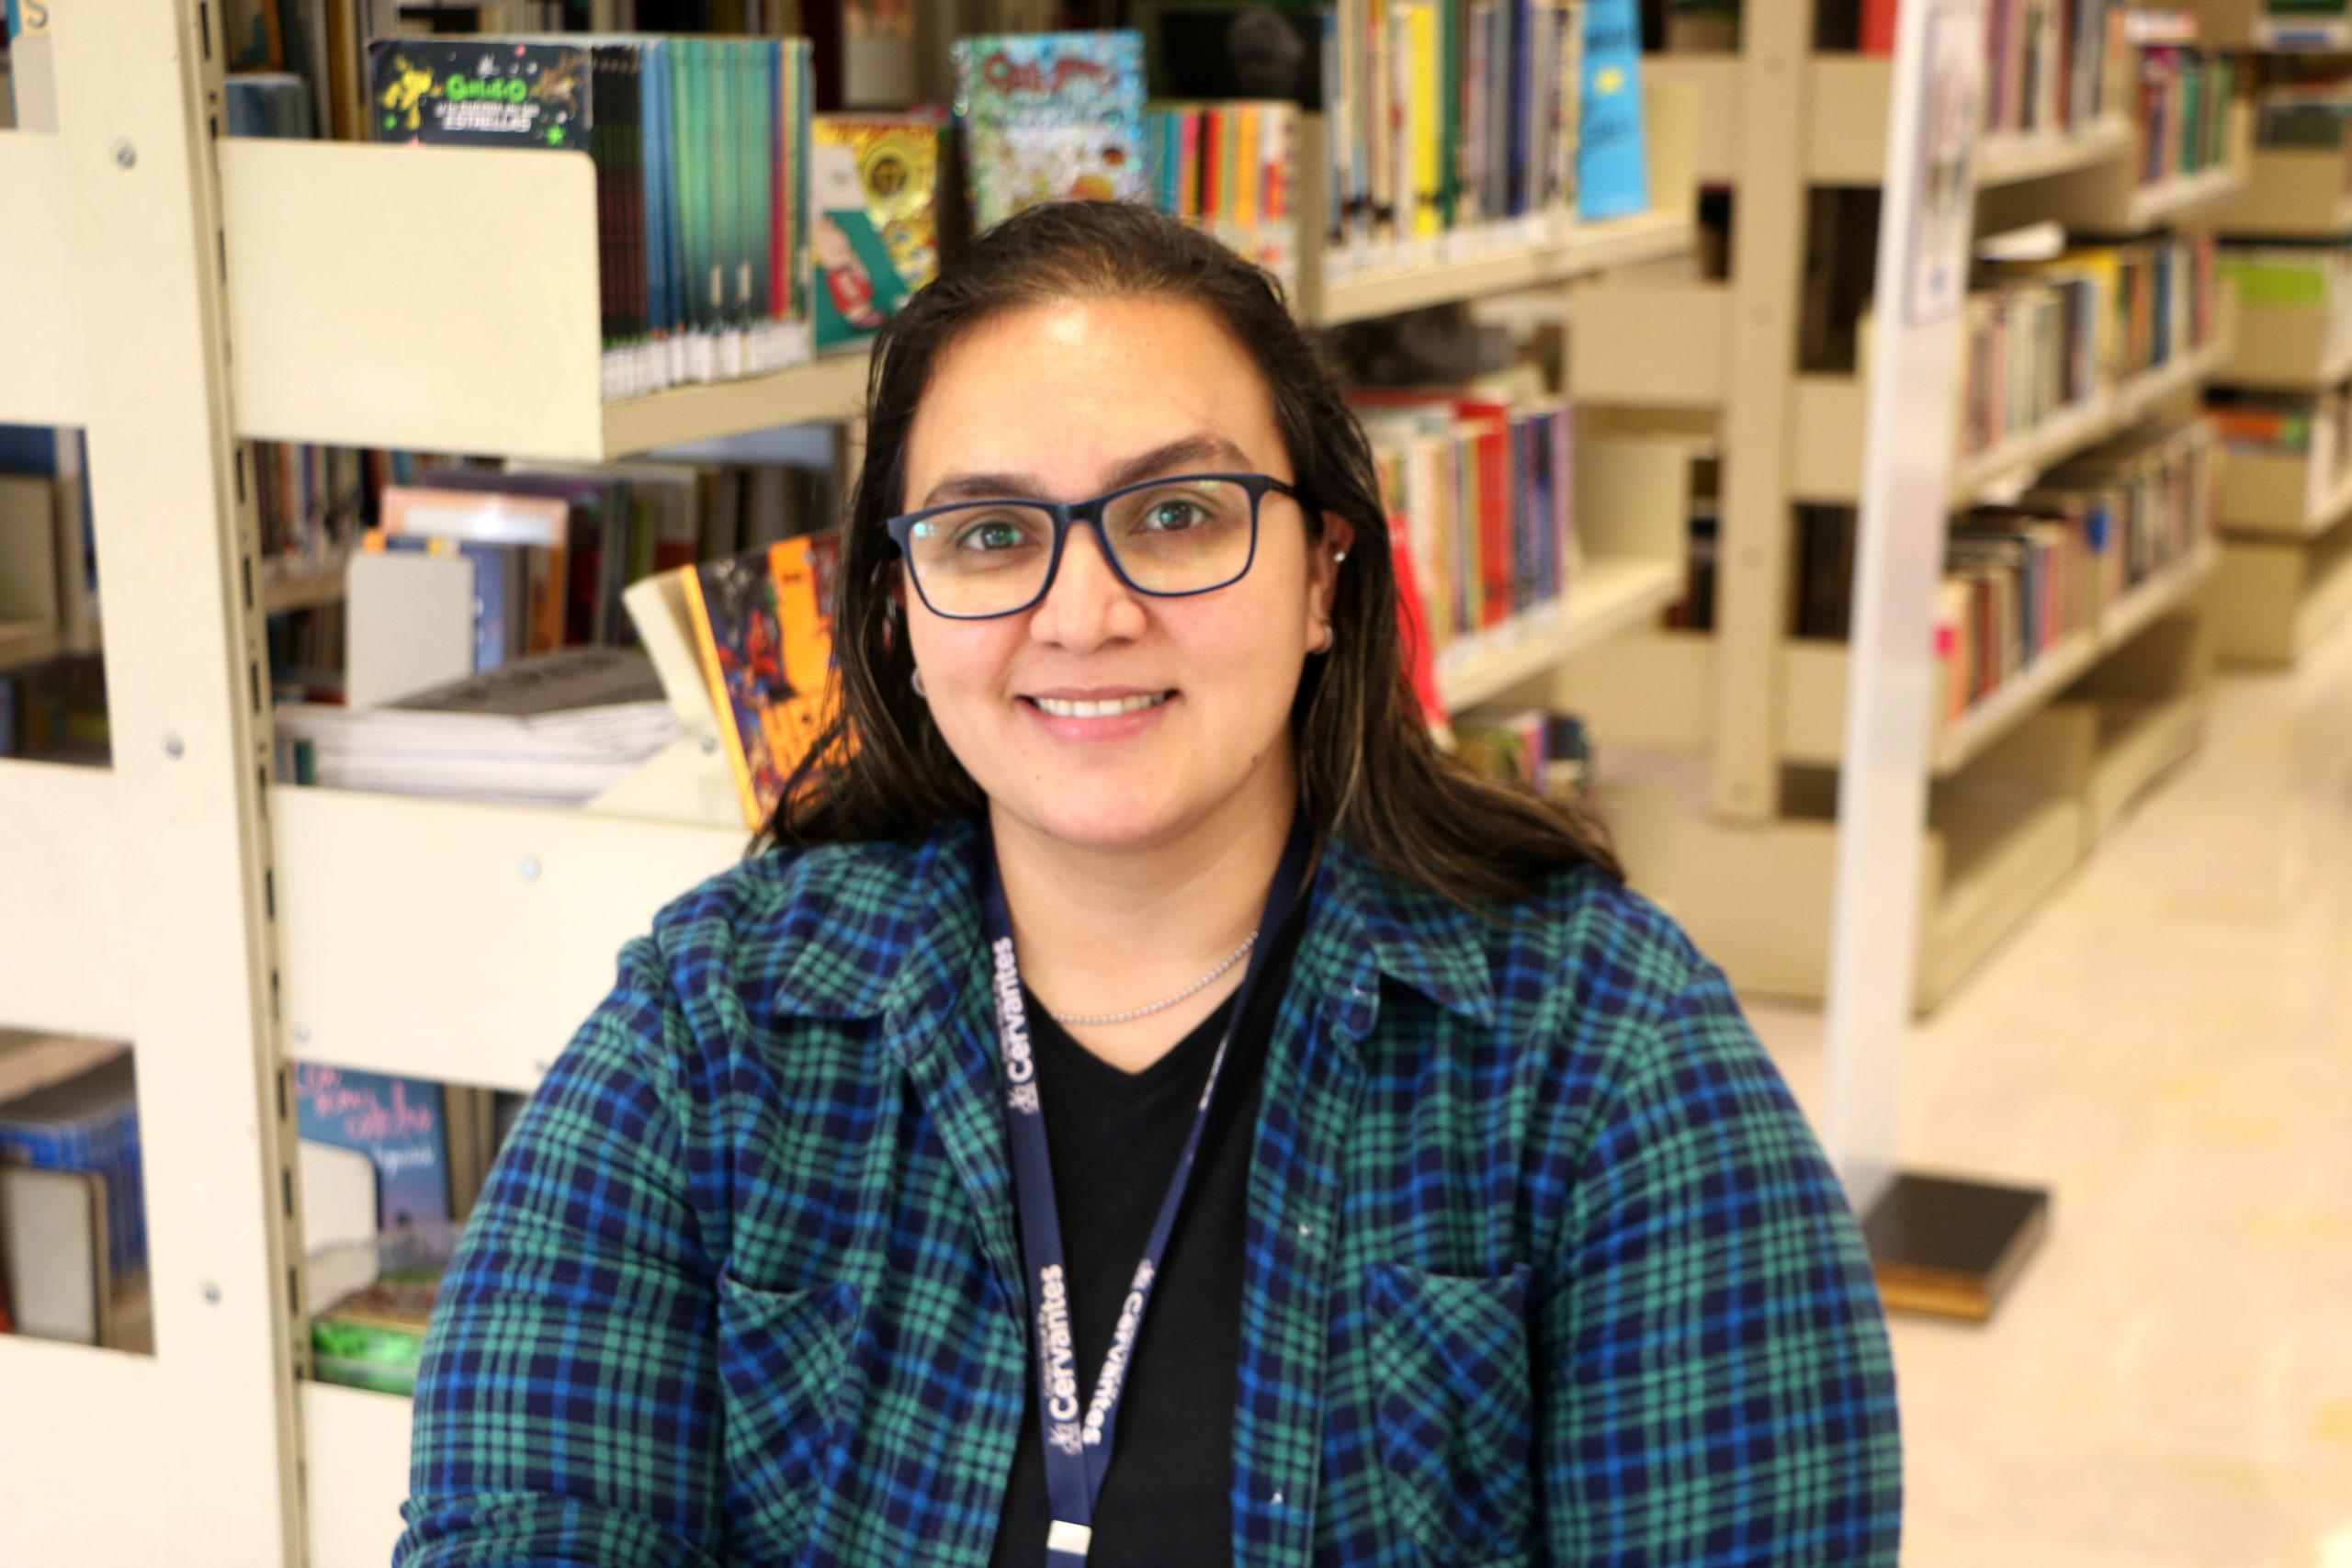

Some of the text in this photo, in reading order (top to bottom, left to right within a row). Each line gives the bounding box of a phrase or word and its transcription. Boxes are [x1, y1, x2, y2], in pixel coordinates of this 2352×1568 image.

[992, 936, 1034, 1083] Cervantes
[1040, 1263, 1079, 1421] Cervantes
[1081, 1291, 1143, 1444] Cervantes
